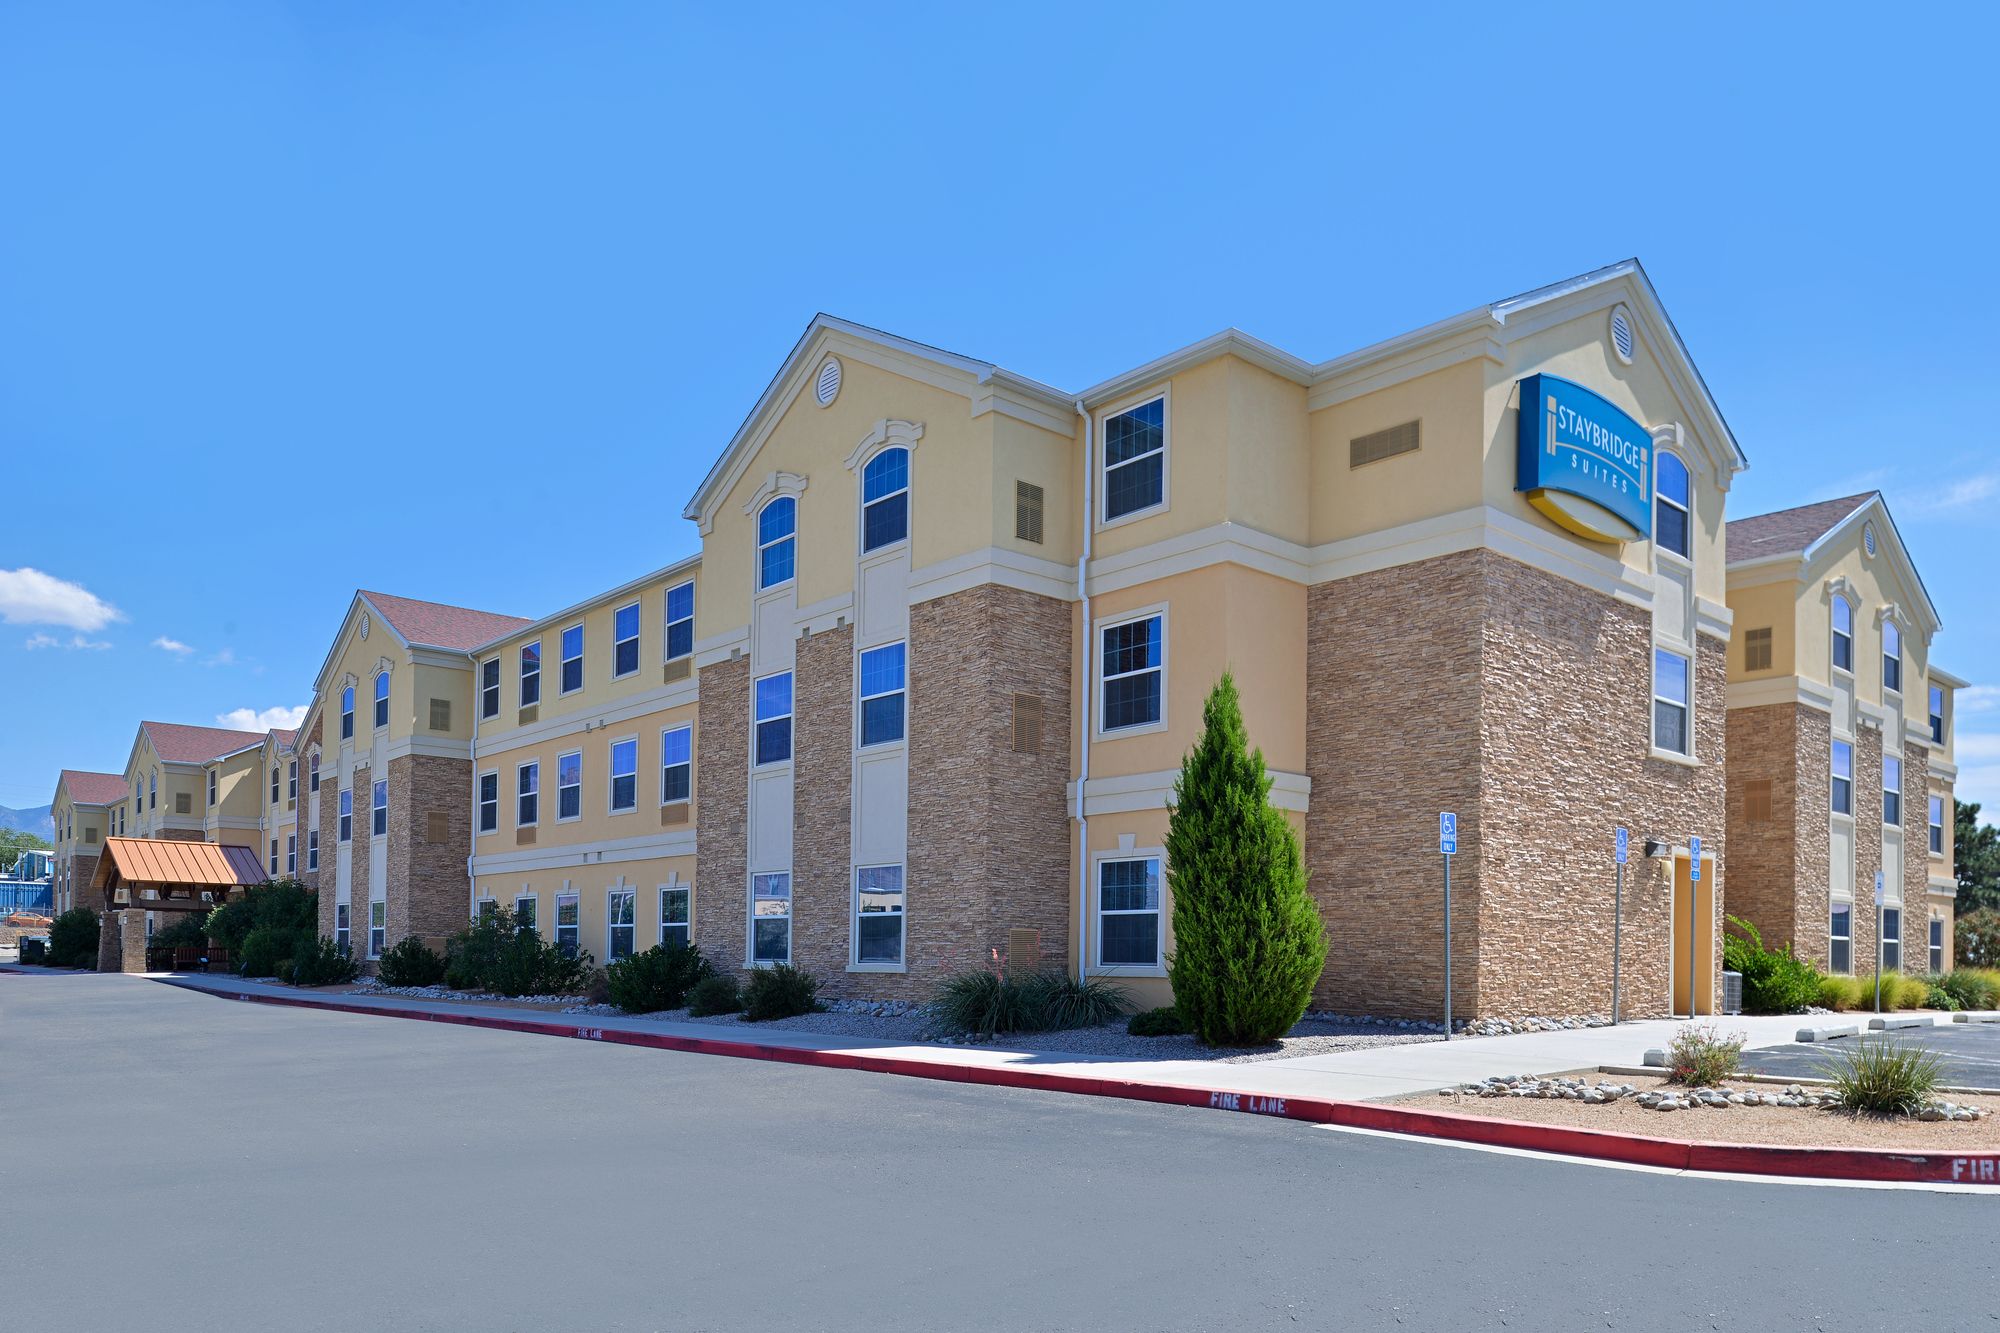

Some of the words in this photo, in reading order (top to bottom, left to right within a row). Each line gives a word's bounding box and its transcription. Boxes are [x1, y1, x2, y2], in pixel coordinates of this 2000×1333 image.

[1558, 405, 1640, 470] STAYBRIDGE
[1571, 454, 1628, 492] SUITES
[1211, 1092, 1240, 1110] FIRE
[1250, 1096, 1286, 1113] LANE
[1953, 1159, 2000, 1180] FIR
